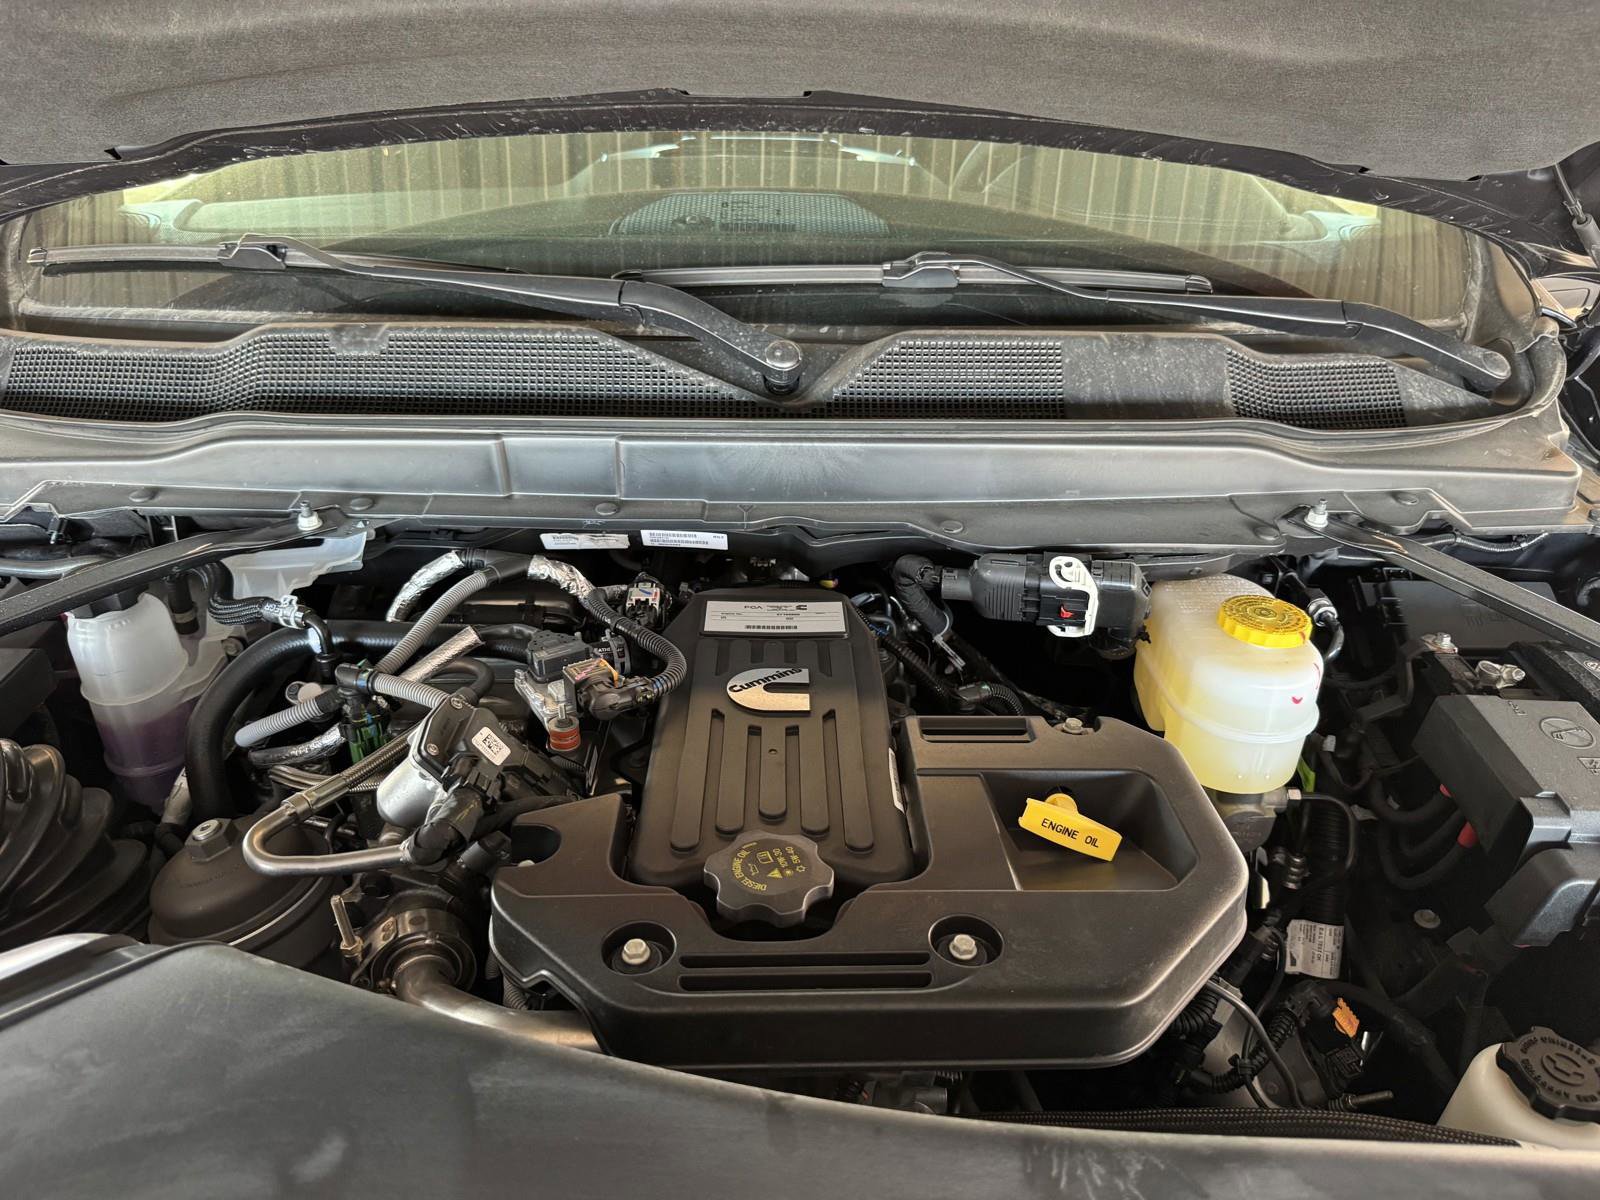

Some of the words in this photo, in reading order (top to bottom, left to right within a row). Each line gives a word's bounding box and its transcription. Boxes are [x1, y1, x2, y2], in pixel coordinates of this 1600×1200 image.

[1041, 818, 1080, 840] ENGINE
[1084, 835, 1099, 848] OIL
[736, 849, 751, 858] OIL
[773, 848, 788, 867] 10W-30
[732, 857, 745, 879] ENGINE
[740, 876, 767, 891] DIESEL
